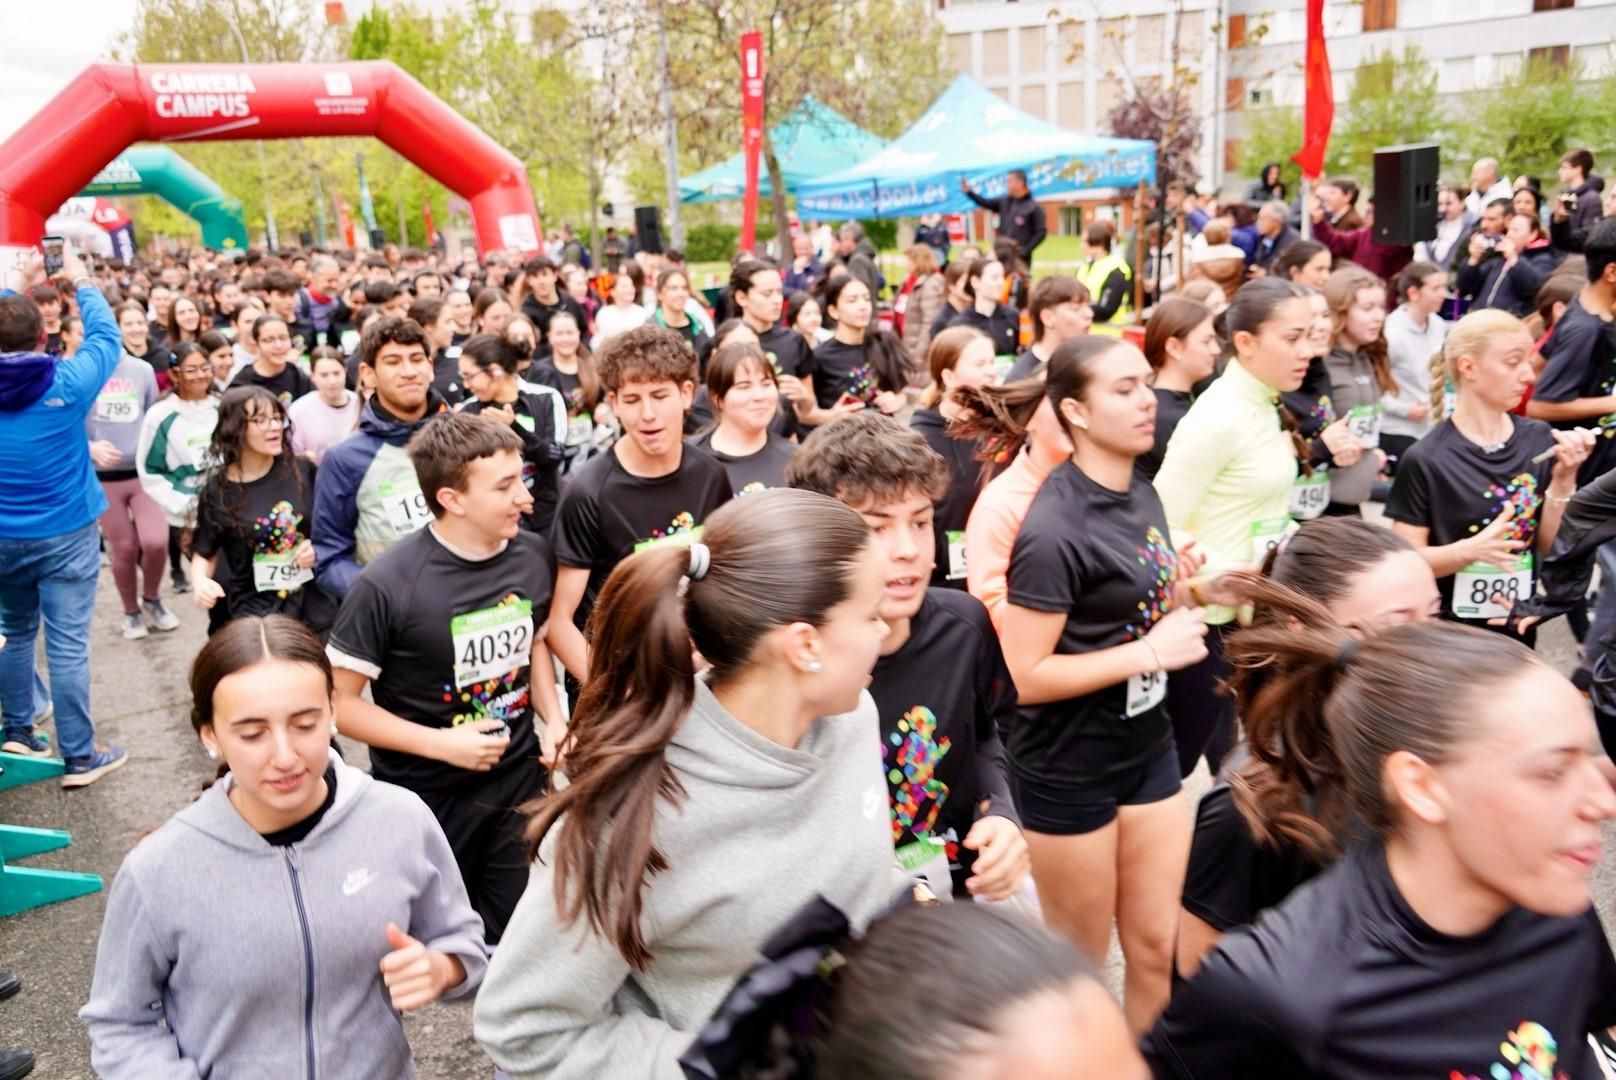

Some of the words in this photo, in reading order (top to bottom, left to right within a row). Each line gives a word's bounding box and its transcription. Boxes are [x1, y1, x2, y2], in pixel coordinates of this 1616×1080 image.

[150, 72, 256, 94] CARRERA
[155, 94, 250, 118] CAMPUS
[105, 402, 131, 415] 795
[398, 493, 431, 520] 19
[1471, 577, 1519, 604] 888
[462, 625, 527, 668] 4032
